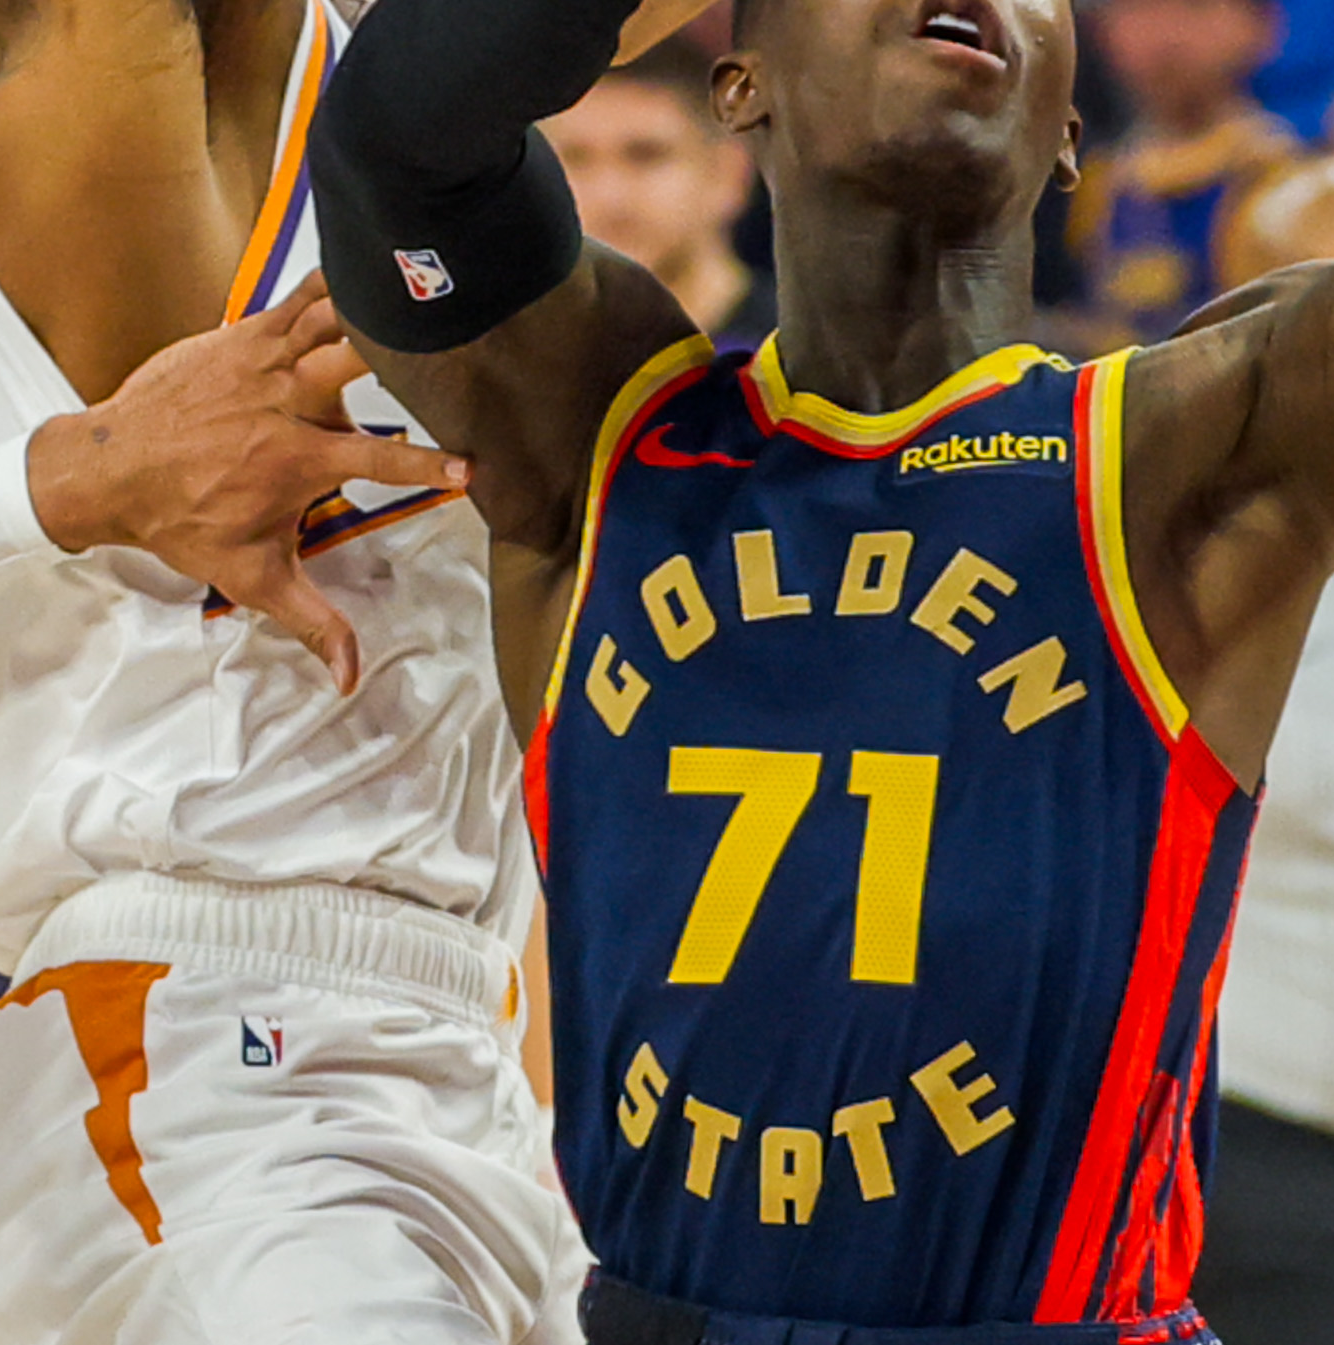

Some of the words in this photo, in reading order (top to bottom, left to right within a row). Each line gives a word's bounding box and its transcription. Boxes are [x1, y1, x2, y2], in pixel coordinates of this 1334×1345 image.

[899, 431, 1067, 474] Rakuten
[584, 529, 1088, 737] GOLDEN
[667, 745, 940, 984] 71
[617, 1040, 1017, 1225] STATE
